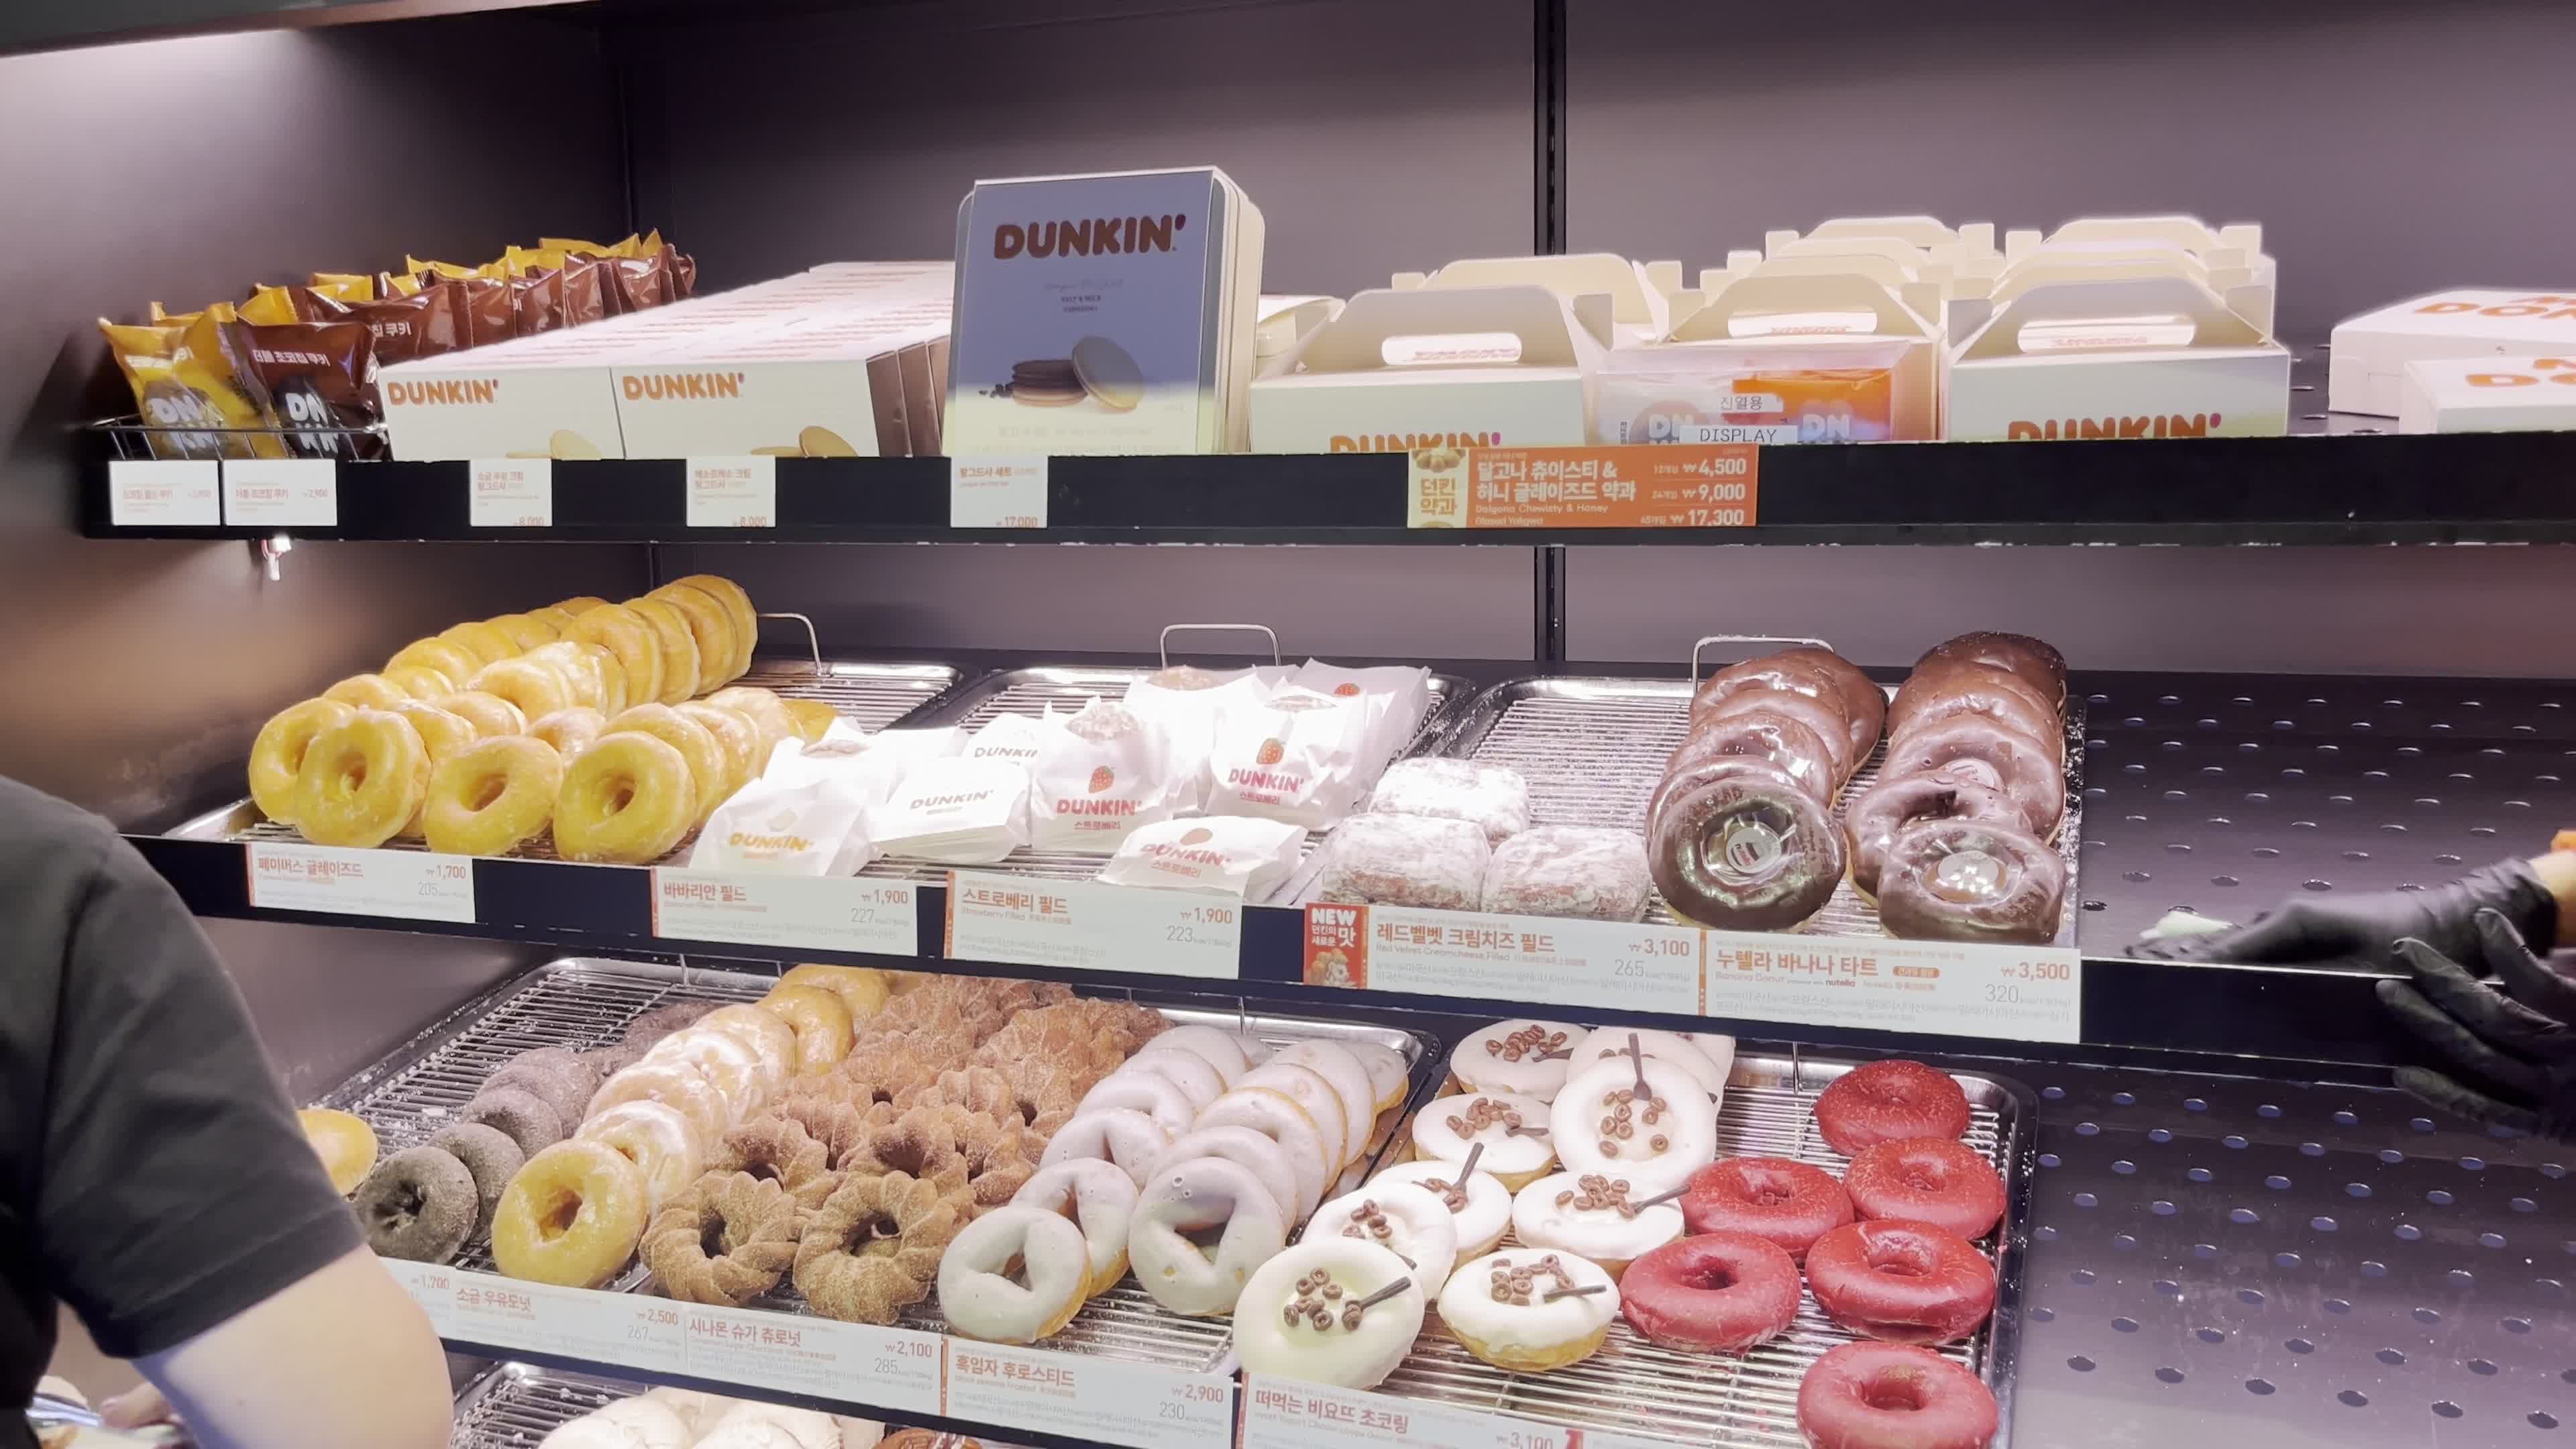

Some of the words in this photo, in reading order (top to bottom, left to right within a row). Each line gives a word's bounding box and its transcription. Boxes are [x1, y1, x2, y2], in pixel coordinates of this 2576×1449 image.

[994, 213, 1187, 260] DUNKIN'
[387, 379, 498, 405] DUNKIN'
[622, 372, 745, 400] DUNKIN'
[1721, 396, 1763, 411] 진열용
[1700, 429, 1777, 442] DISPLAY
[1477, 461, 1527, 481] 달고나
[1530, 460, 1599, 481] 츄이스티
[1602, 461, 1617, 478] &
[1682, 458, 1747, 476] ₩4,500
[1420, 478, 1456, 496] 던킨
[1477, 482, 1509, 502] 허니
[1513, 482, 1598, 502] 글레이즈드
[1601, 480, 1636, 502] 약과
[1682, 484, 1746, 503] ₩9,000
[1420, 498, 1456, 516] 약과
[1577, 503, 1609, 514] Honey
[1670, 510, 1745, 526] ₩17,300
[1228, 768, 1305, 793] DUNKIN'
[910, 789, 996, 809] DUNKIN'
[1057, 798, 1142, 816] DUNKIN'
[1140, 843, 1232, 866] DUNKIN'
[307, 859, 364, 878] 글레이즈드
[425, 865, 467, 879] ₩1,700
[418, 882, 439, 896] 205
[664, 881, 717, 901] 바바리안
[720, 884, 747, 902] 필드
[861, 889, 908, 906] ₩1,900
[962, 888, 1034, 913] 스트로베리
[1039, 896, 1069, 914] 필드
[851, 907, 875, 923] 227
[1180, 908, 1233, 924] ₩1,900
[1311, 908, 1356, 926] NEW
[1167, 925, 1193, 943] 223
[1338, 926, 1356, 948] 맛
[1377, 922, 1443, 945] 레드벨벳
[1447, 928, 1516, 950] 크림치즈
[1521, 932, 1556, 953] 필드
[1628, 938, 1690, 957] ₩3,100
[1615, 959, 1646, 977] 265
[1717, 949, 1772, 972] 누텔라
[1778, 953, 1835, 976] 바나나
[1840, 956, 1879, 977] 타트
[2000, 962, 2071, 981] ₩3,500
[1825, 979, 1856, 987] nutella
[1985, 983, 2019, 1004] 320
[456, 1288, 480, 1305] 소금
[635, 1309, 678, 1326] ₩2,500
[689, 1317, 729, 1339] 시나몬
[732, 1324, 757, 1343] 슈가
[761, 1327, 802, 1348] 츄로넛
[885, 1341, 932, 1358] ₩2,100
[875, 1358, 898, 1375] 285
[956, 1354, 998, 1377] 흑임자
[1002, 1360, 1075, 1388] 후로스티드
[1171, 1384, 1224, 1403] ₩2,900
[1159, 1401, 1185, 1420] 230
[1256, 1389, 1304, 1415] 떠먹는
[1308, 1399, 1356, 1423] 비요뜨
[1359, 1407, 1409, 1435] 초코링
